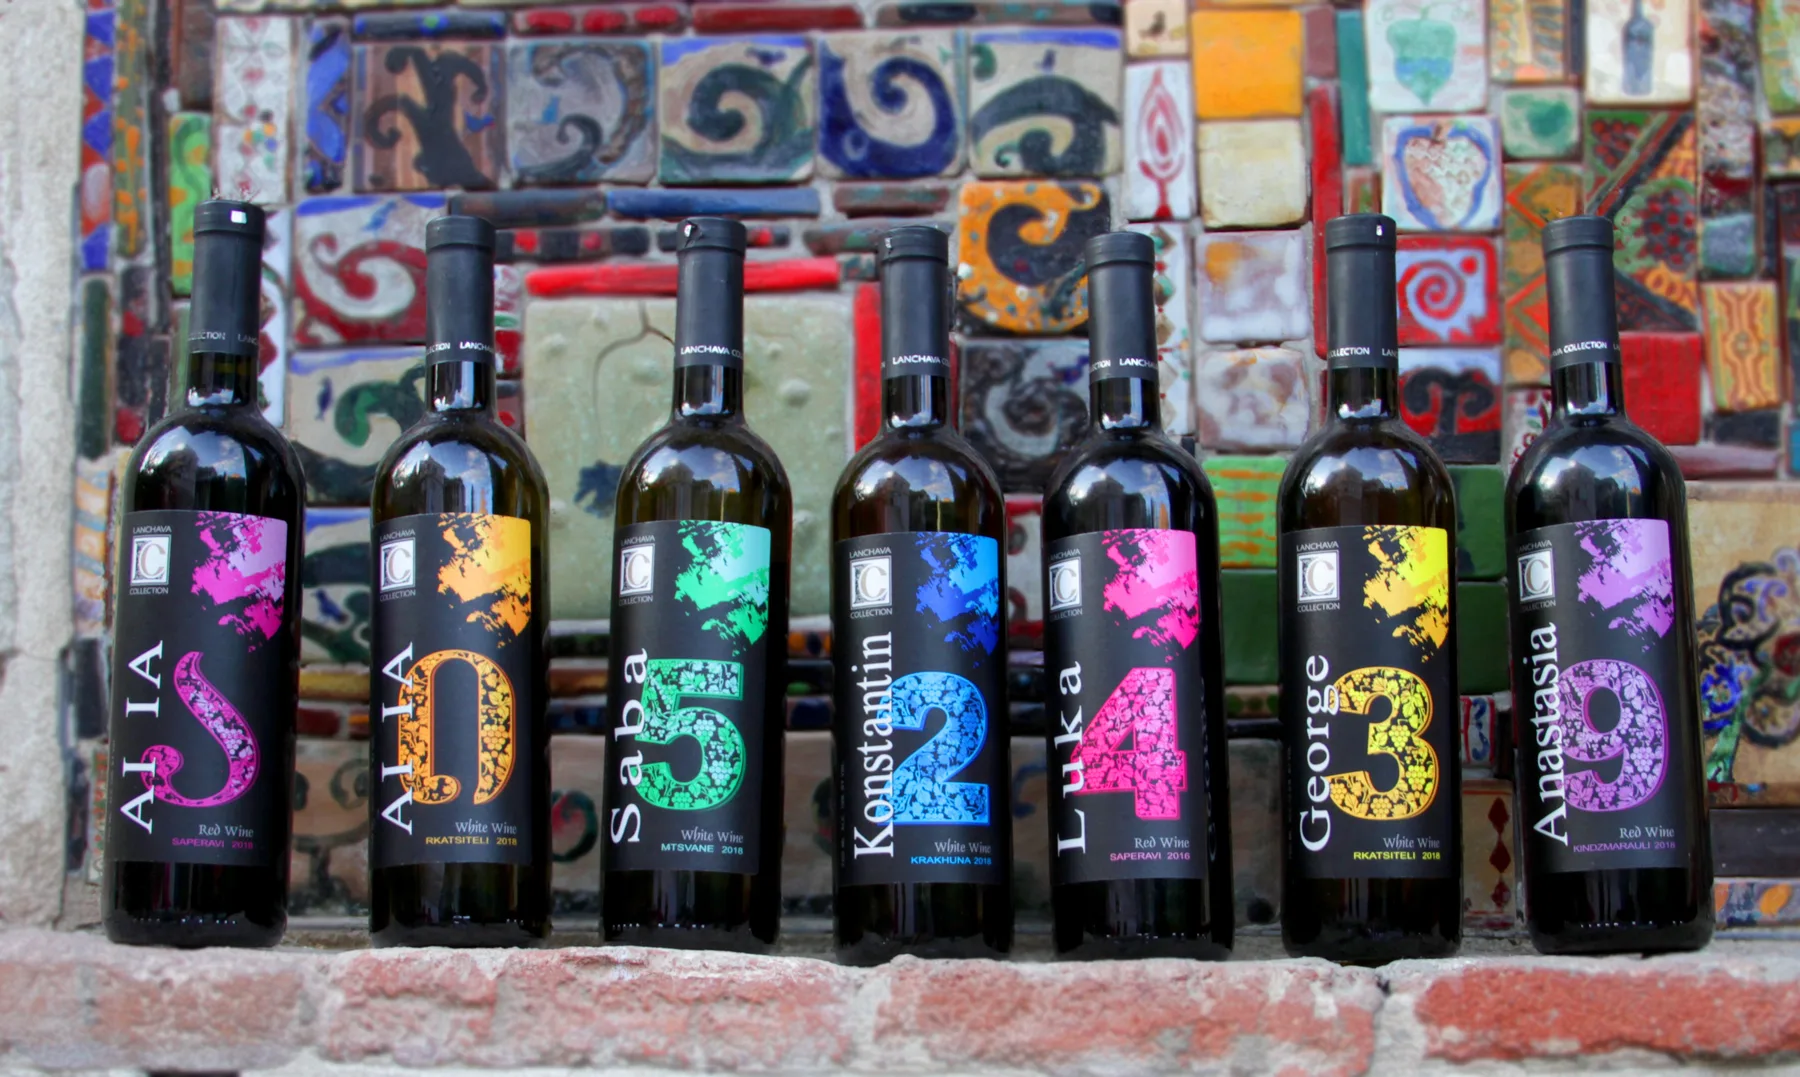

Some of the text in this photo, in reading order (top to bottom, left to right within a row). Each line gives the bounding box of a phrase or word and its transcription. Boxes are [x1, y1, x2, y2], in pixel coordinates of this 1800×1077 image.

[680, 344, 730, 355] LANCHAVA
[1563, 341, 1608, 354] COLLECTION
[892, 354, 940, 365] LANCHAVA
[132, 525, 172, 534] LANCHAVA
[380, 529, 416, 542] LANCHAVA
[850, 546, 892, 558] LANCHAVA
[1297, 541, 1340, 552] LANCHAVA
[129, 587, 169, 595] COLLECTION
[380, 589, 416, 602] COLLECTION
[850, 608, 893, 619] COLLECTION
[1297, 602, 1341, 613] COLLECTION
[631, 658, 746, 811] 5
[1523, 622, 1568, 846] Anastasia
[1551, 659, 1669, 812] 9
[610, 648, 648, 844] Saba
[854, 631, 894, 860] Konstantin
[875, 671, 990, 826] 2
[1071, 666, 1187, 820] 4
[1326, 666, 1439, 820] 3
[1054, 661, 1086, 858] Luka
[1300, 655, 1340, 851] George
[198, 823, 254, 838] Red Wine
[455, 818, 517, 835] White Wine
[1619, 825, 1675, 839] Red Wine
[425, 835, 518, 846] RKATSITELI 2018
[681, 826, 744, 843] White Wine
[172, 837, 225, 848] SAPERAVI
[934, 838, 992, 854] White Wine
[1134, 836, 1190, 849] Red Wine
[1383, 833, 1440, 850] White Wine
[1573, 841, 1676, 853] KINDZMARAULI 2018
[661, 843, 743, 855] MTSVANE 2018
[1353, 851, 1441, 860] RKATSITELI 2018
[910, 856, 992, 865] KRAKHUNA 2018
[1110, 852, 1191, 861] SAPERAVI 2016
